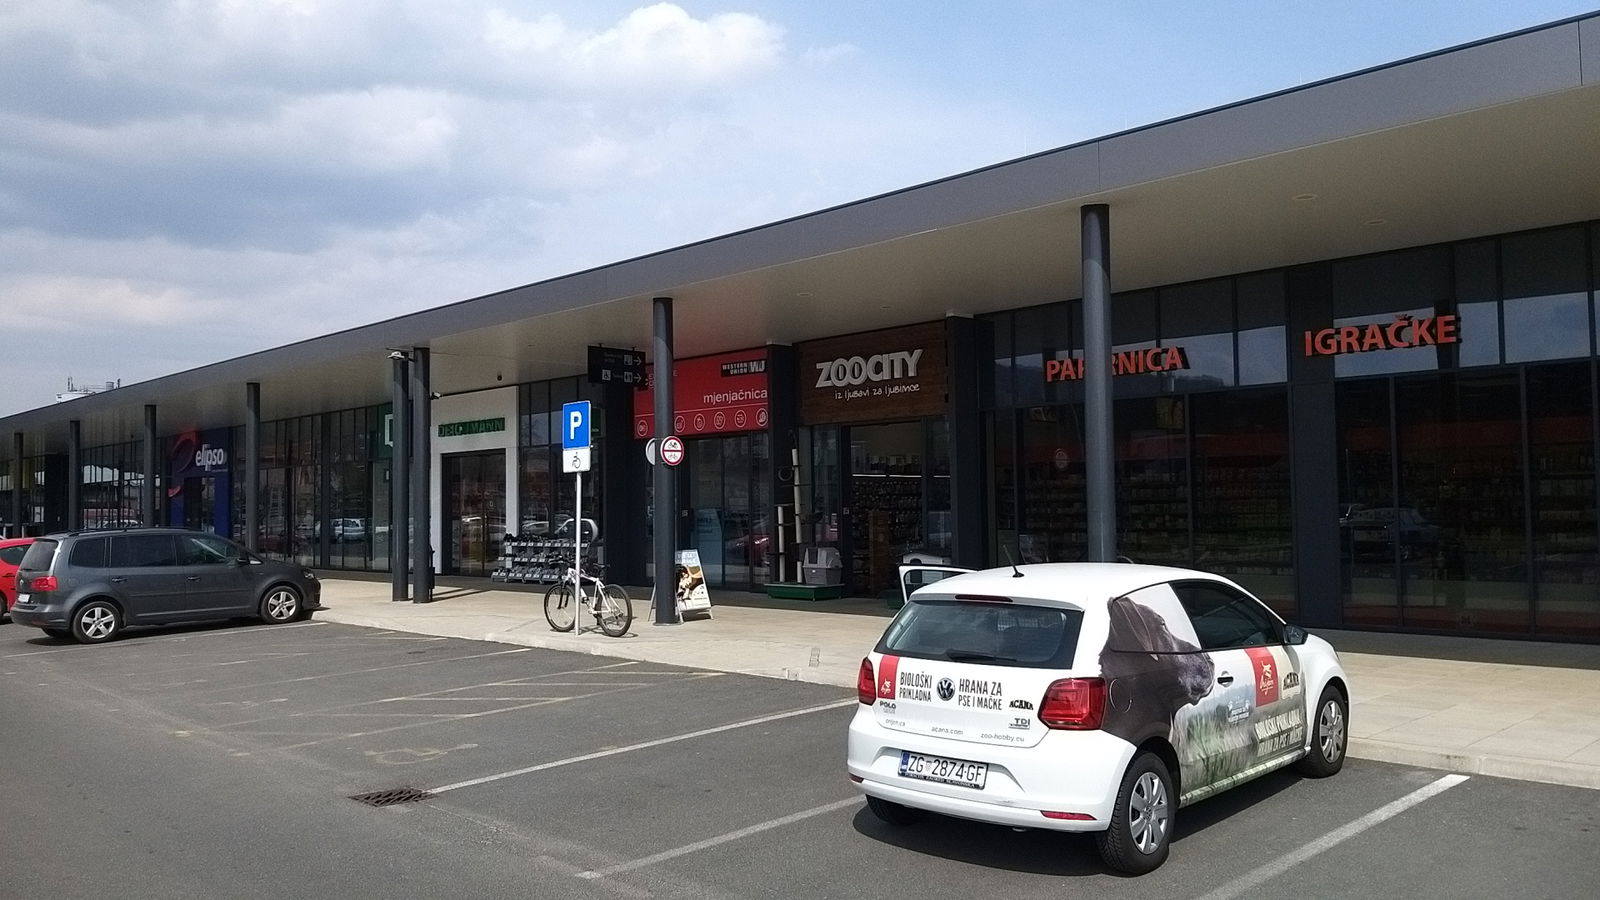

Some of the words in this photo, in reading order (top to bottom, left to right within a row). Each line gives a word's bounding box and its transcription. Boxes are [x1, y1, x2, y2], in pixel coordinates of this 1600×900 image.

[1304, 314, 1457, 357] IGRAČKE
[730, 367, 748, 375] UNION
[815, 348, 923, 388] ZOOCITY
[1046, 345, 1184, 382] PANICA
[703, 388, 768, 405] mjenjačnica
[834, 390, 843, 399] iz
[872, 388, 882, 396] za
[570, 411, 582, 440] P
[195, 443, 224, 472] elipso
[900, 671, 933, 689] BIOLOŠKI
[958, 678, 988, 695] HRANA
[991, 681, 1003, 697] ZA
[899, 687, 932, 703] PRIKLADNA
[958, 695, 971, 708] PSE
[976, 695, 1003, 711] MAČKE
[879, 700, 897, 710] POLO
[1009, 700, 1034, 710] ACANA
[1014, 718, 1031, 726] TDI
[931, 726, 963, 736] acana.com
[980, 732, 1025, 743] zoo-hobby.eu
[908, 755, 924, 773] ZG
